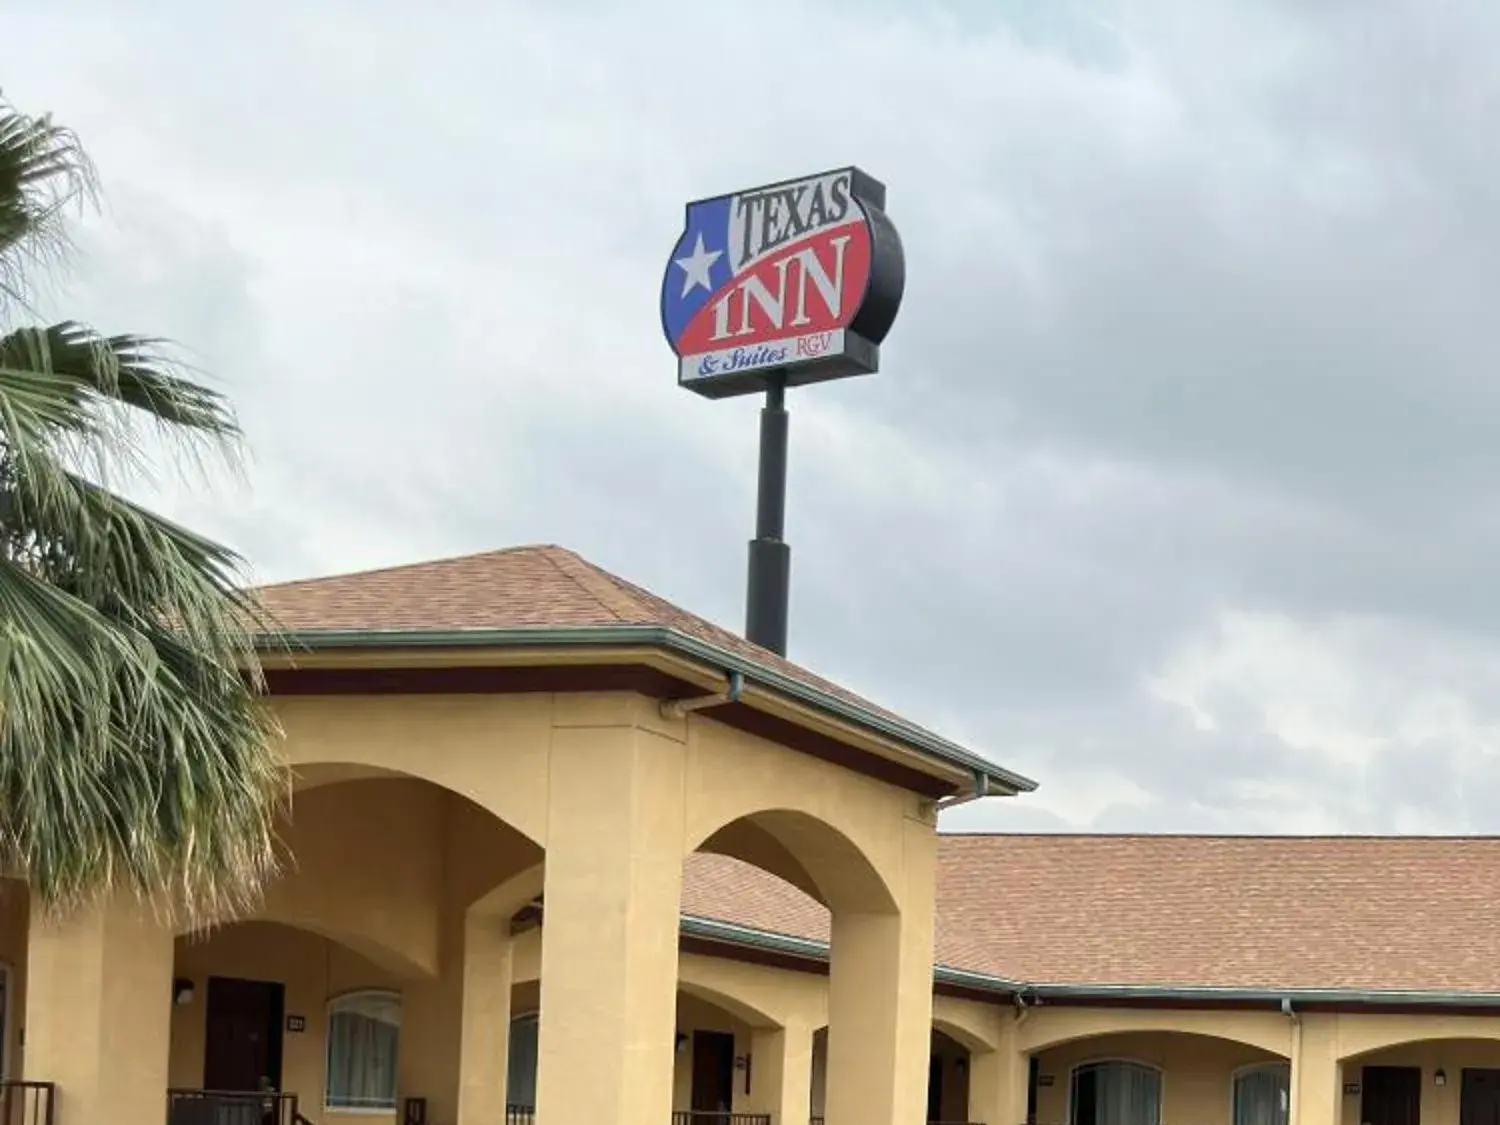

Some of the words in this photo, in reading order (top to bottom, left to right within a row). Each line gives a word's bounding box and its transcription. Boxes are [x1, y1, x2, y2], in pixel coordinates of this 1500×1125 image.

[736, 175, 849, 267] TEXAS
[709, 235, 851, 342] INN
[699, 354, 719, 375] &
[723, 345, 789, 371] Suites
[796, 332, 832, 357] RGV
